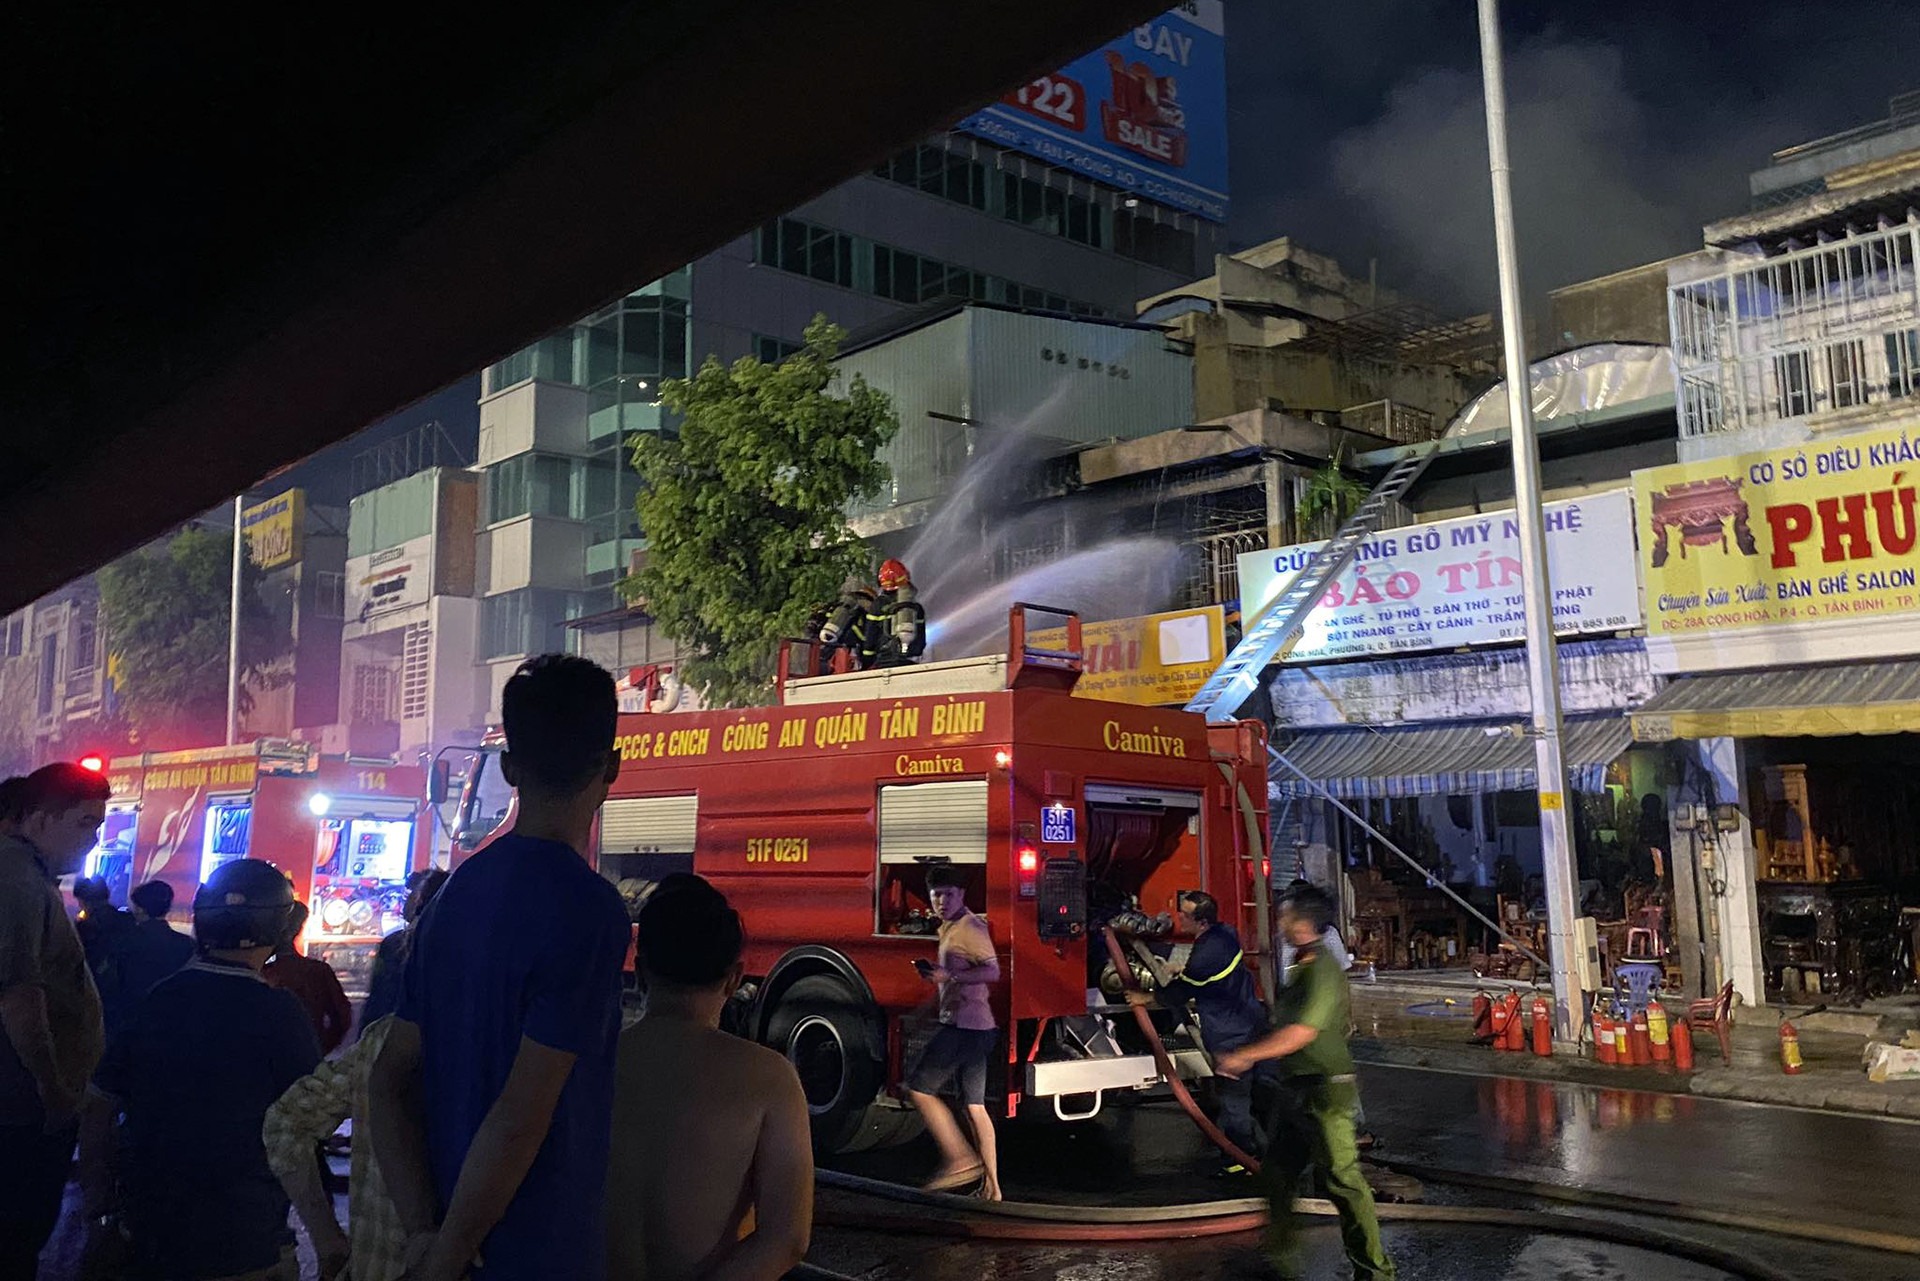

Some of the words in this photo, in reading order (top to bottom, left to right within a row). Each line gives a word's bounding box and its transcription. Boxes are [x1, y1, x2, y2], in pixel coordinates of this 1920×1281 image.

[1134, 23, 1192, 67] BAY
[1117, 119, 1172, 160] SALE
[1407, 526, 1440, 554] GỖ
[1450, 519, 1492, 547] MỸ
[1503, 505, 1582, 538] NHỆ
[1765, 471, 1918, 569] PHÚ
[1318, 565, 1421, 608] BẢO
[1777, 578, 1812, 600] BÀN
[1818, 569, 1849, 595] GHẾ
[1857, 568, 1916, 591] SALON
[653, 731, 666, 758] &
[668, 728, 711, 756] CNCH
[721, 716, 769, 753] CÔNG
[778, 719, 806, 748] AN
[814, 707, 868, 750] QUẬN
[880, 701, 920, 740] TÂN
[931, 697, 986, 736] BÌNH
[1103, 720, 1186, 757] Camiva
[357, 770, 387, 790] 114
[895, 754, 964, 777] Camiva
[1045, 826, 1071, 841] 0251
[1047, 810, 1070, 825] 51F
